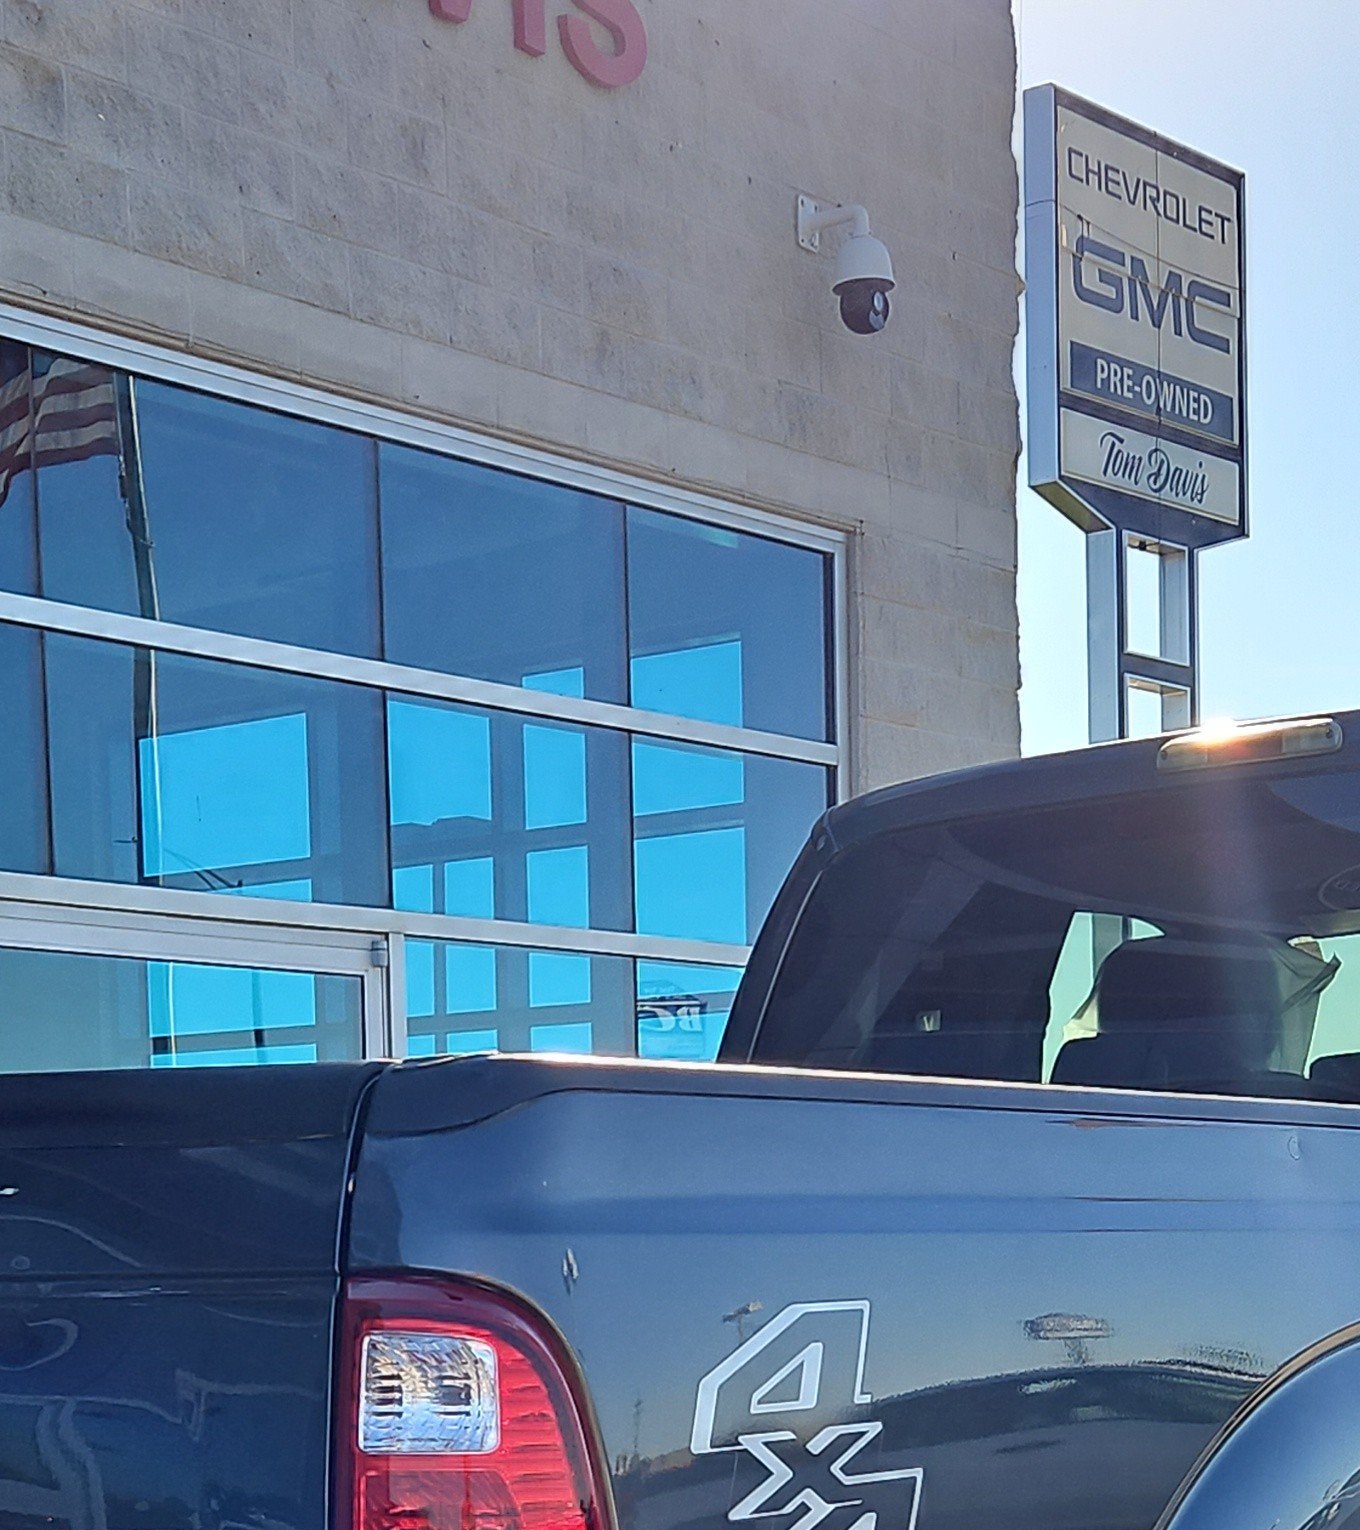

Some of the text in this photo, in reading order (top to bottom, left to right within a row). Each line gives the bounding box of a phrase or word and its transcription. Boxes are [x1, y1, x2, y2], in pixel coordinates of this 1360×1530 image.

[1067, 145, 1233, 245] CHEVROLET
[1071, 233, 1232, 356] GMC
[1095, 357, 1214, 426] PRE-OWNED
[1099, 431, 1209, 505] Tom Davis
